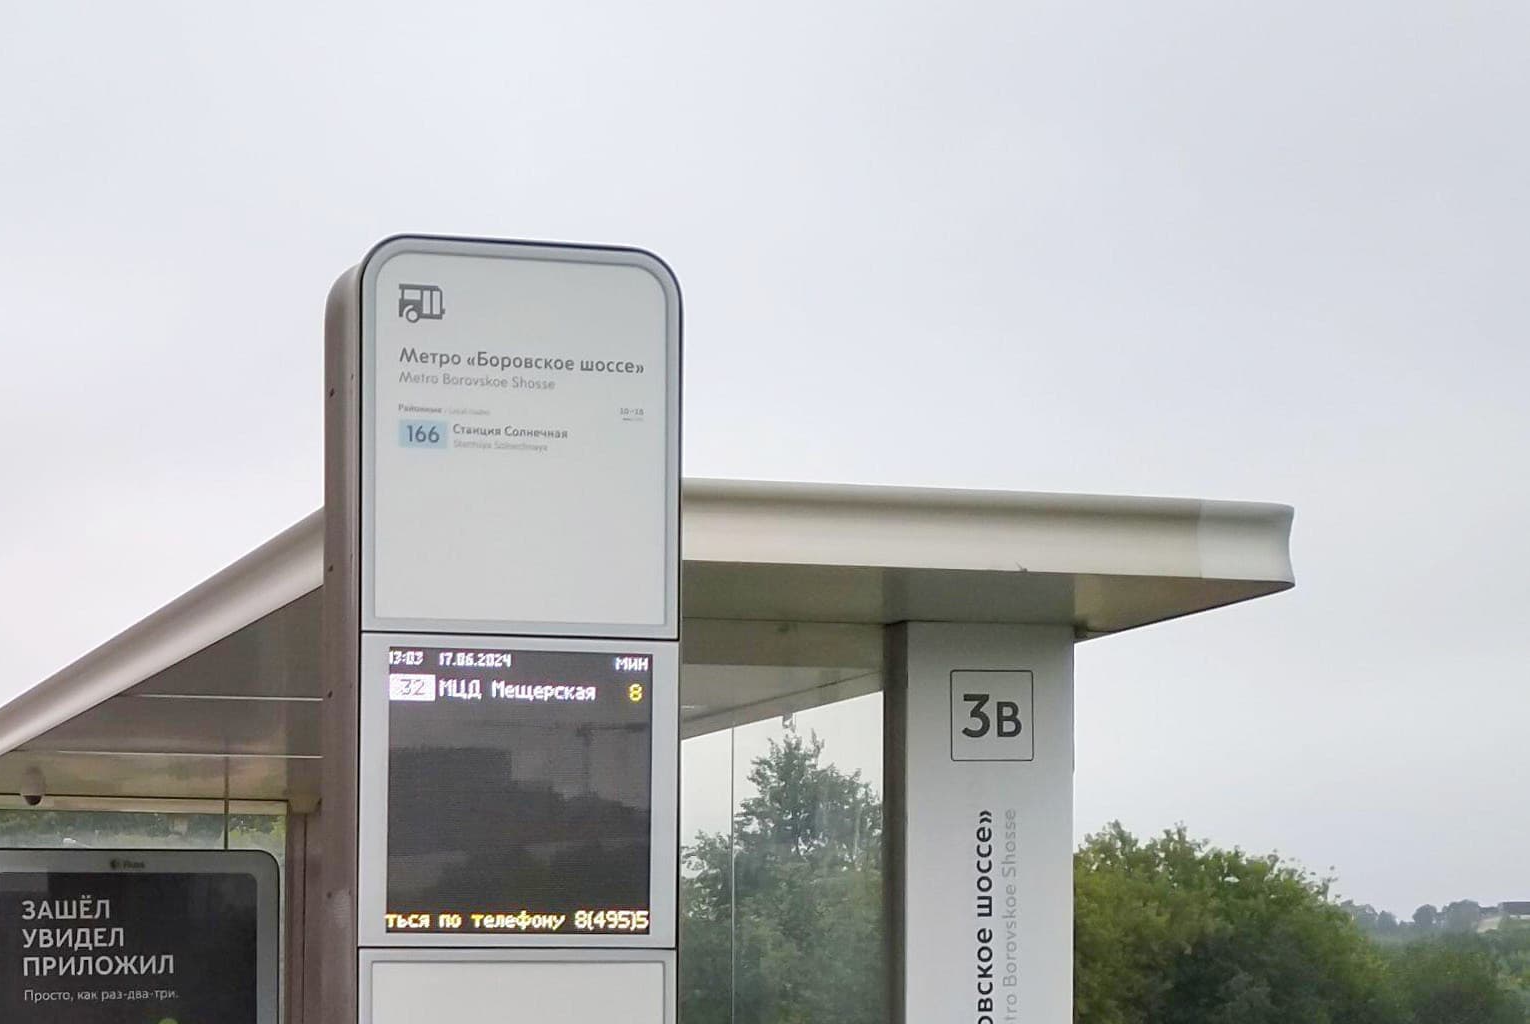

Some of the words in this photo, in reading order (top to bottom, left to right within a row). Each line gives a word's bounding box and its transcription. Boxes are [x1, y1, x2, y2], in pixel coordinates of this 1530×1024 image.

[399, 347, 461, 368] Метро
[467, 351, 574, 371] «Боровское
[580, 359, 644, 374] шоссе»
[399, 371, 439, 385] Metro
[442, 373, 508, 388] Borovskoe
[512, 376, 556, 390] Shosse
[406, 424, 440, 443] 166
[452, 423, 501, 437] Станция
[504, 426, 568, 439] Солнечная
[389, 651, 424, 665] 13:03
[438, 652, 511, 667] 17.06.2024
[399, 679, 427, 696] 32
[438, 679, 482, 699] МЦД
[491, 680, 596, 701] Мещерская
[628, 683, 643, 702] 8
[1001, 809, 1017, 877] Shosse
[975, 810, 994, 917] шоссе»
[21, 894, 111, 920] ЗАШЁЛ
[438, 913, 462, 929] по
[471, 909, 566, 931] телефону
[21, 928, 124, 951] УВИДЕЛ
[1002, 885, 1017, 988] Borovskoe
[23, 955, 175, 977] ПРИЛОЖИЛ
[24, 989, 74, 1002] Просто,
[77, 990, 98, 1000] как
